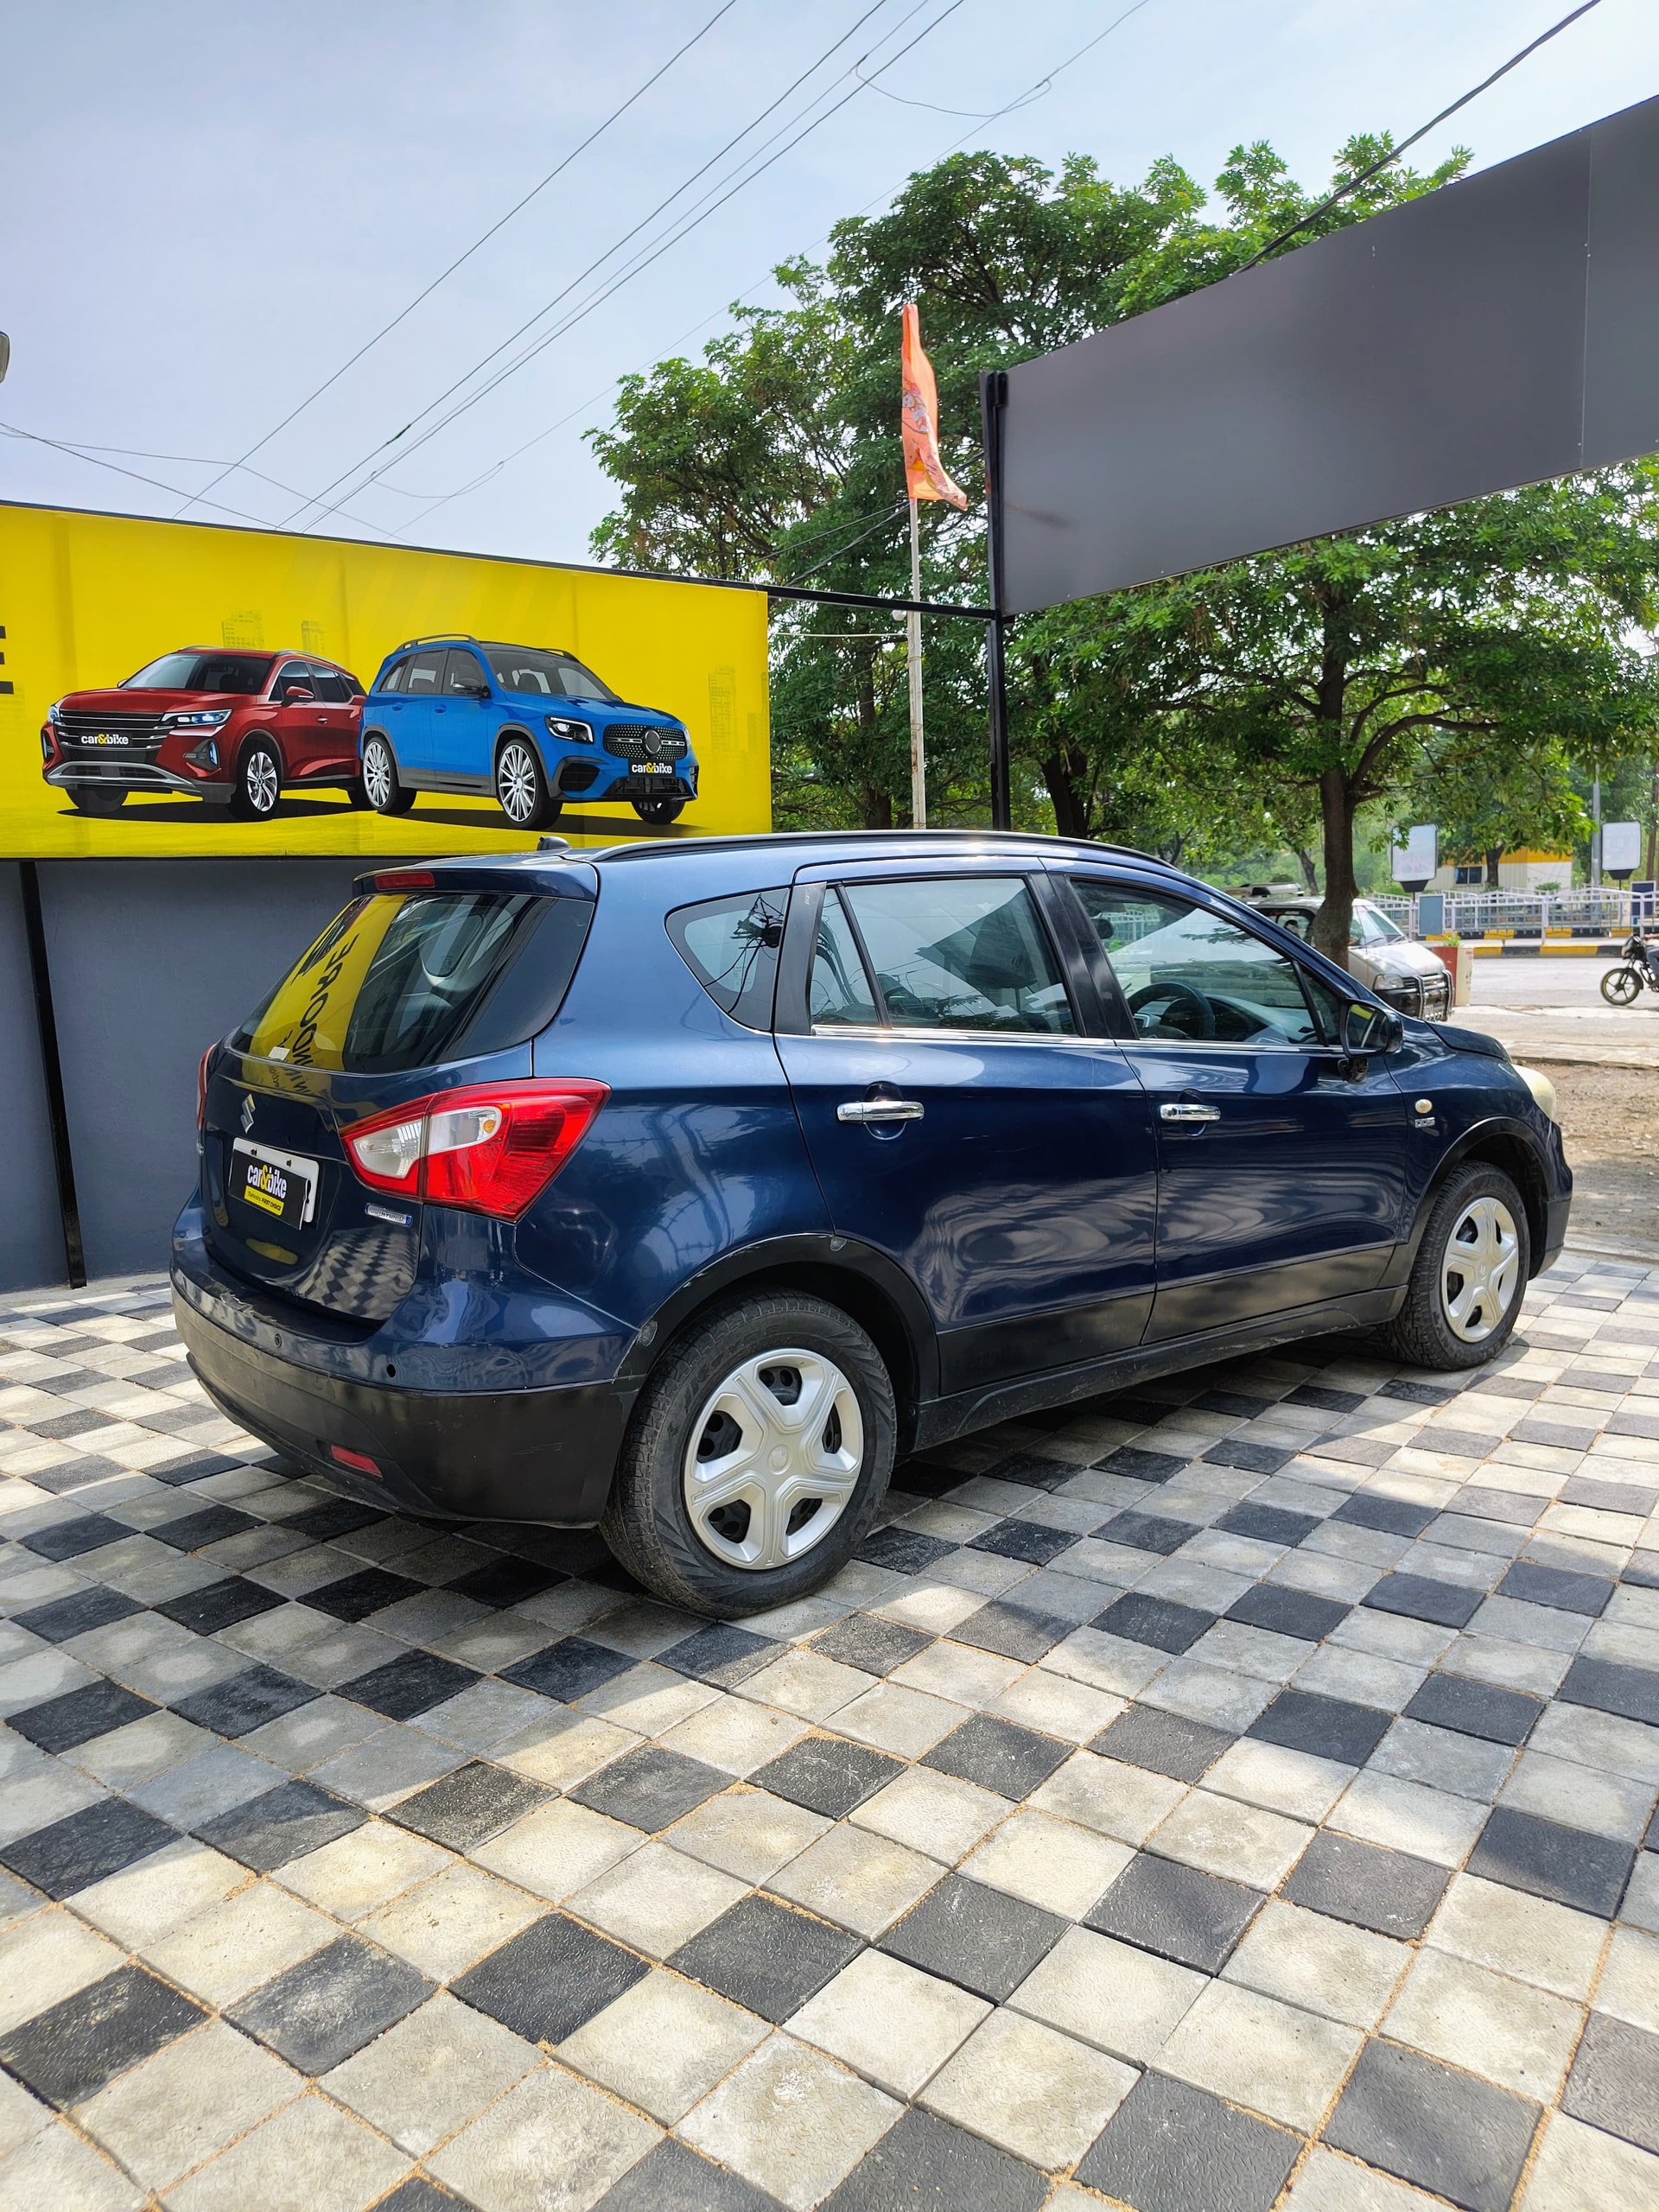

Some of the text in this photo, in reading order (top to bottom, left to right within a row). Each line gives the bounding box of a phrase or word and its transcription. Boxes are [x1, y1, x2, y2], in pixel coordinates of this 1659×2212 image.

[80, 734, 129, 745] car&bike
[631, 762, 672, 774] car&bike
[247, 1165, 287, 1198] car&bike
